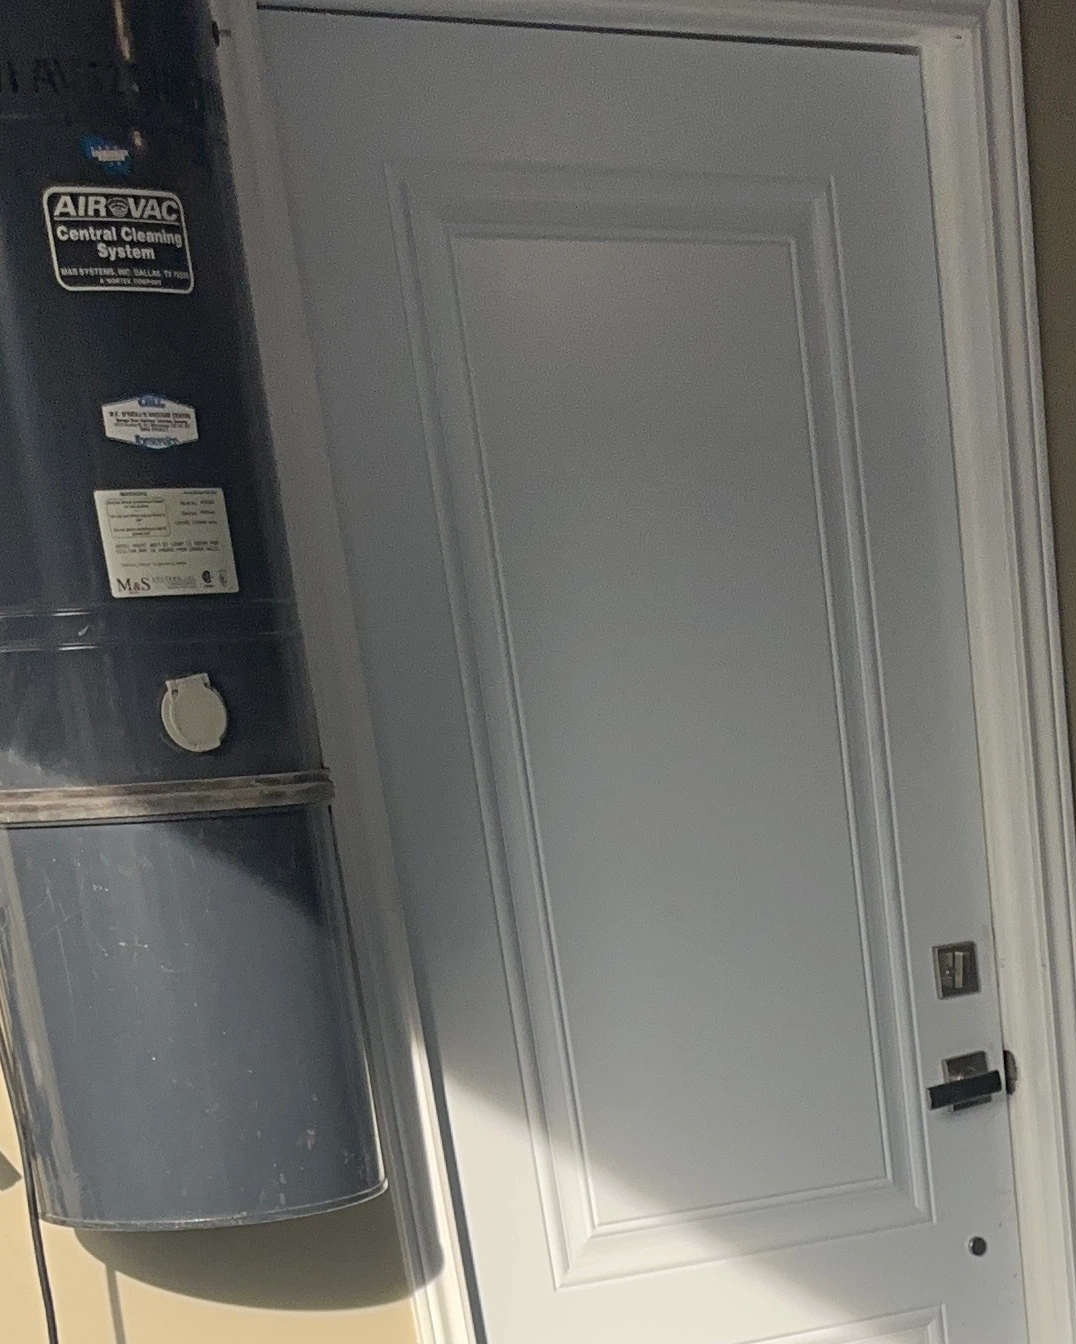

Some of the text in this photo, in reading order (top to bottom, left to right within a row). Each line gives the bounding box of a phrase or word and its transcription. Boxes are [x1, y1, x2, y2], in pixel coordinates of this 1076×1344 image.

[54, 195, 179, 221] AIR VAC
[56, 225, 182, 248] Central Cleaning
[97, 242, 155, 261] System
[116, 577, 151, 592] M&S
